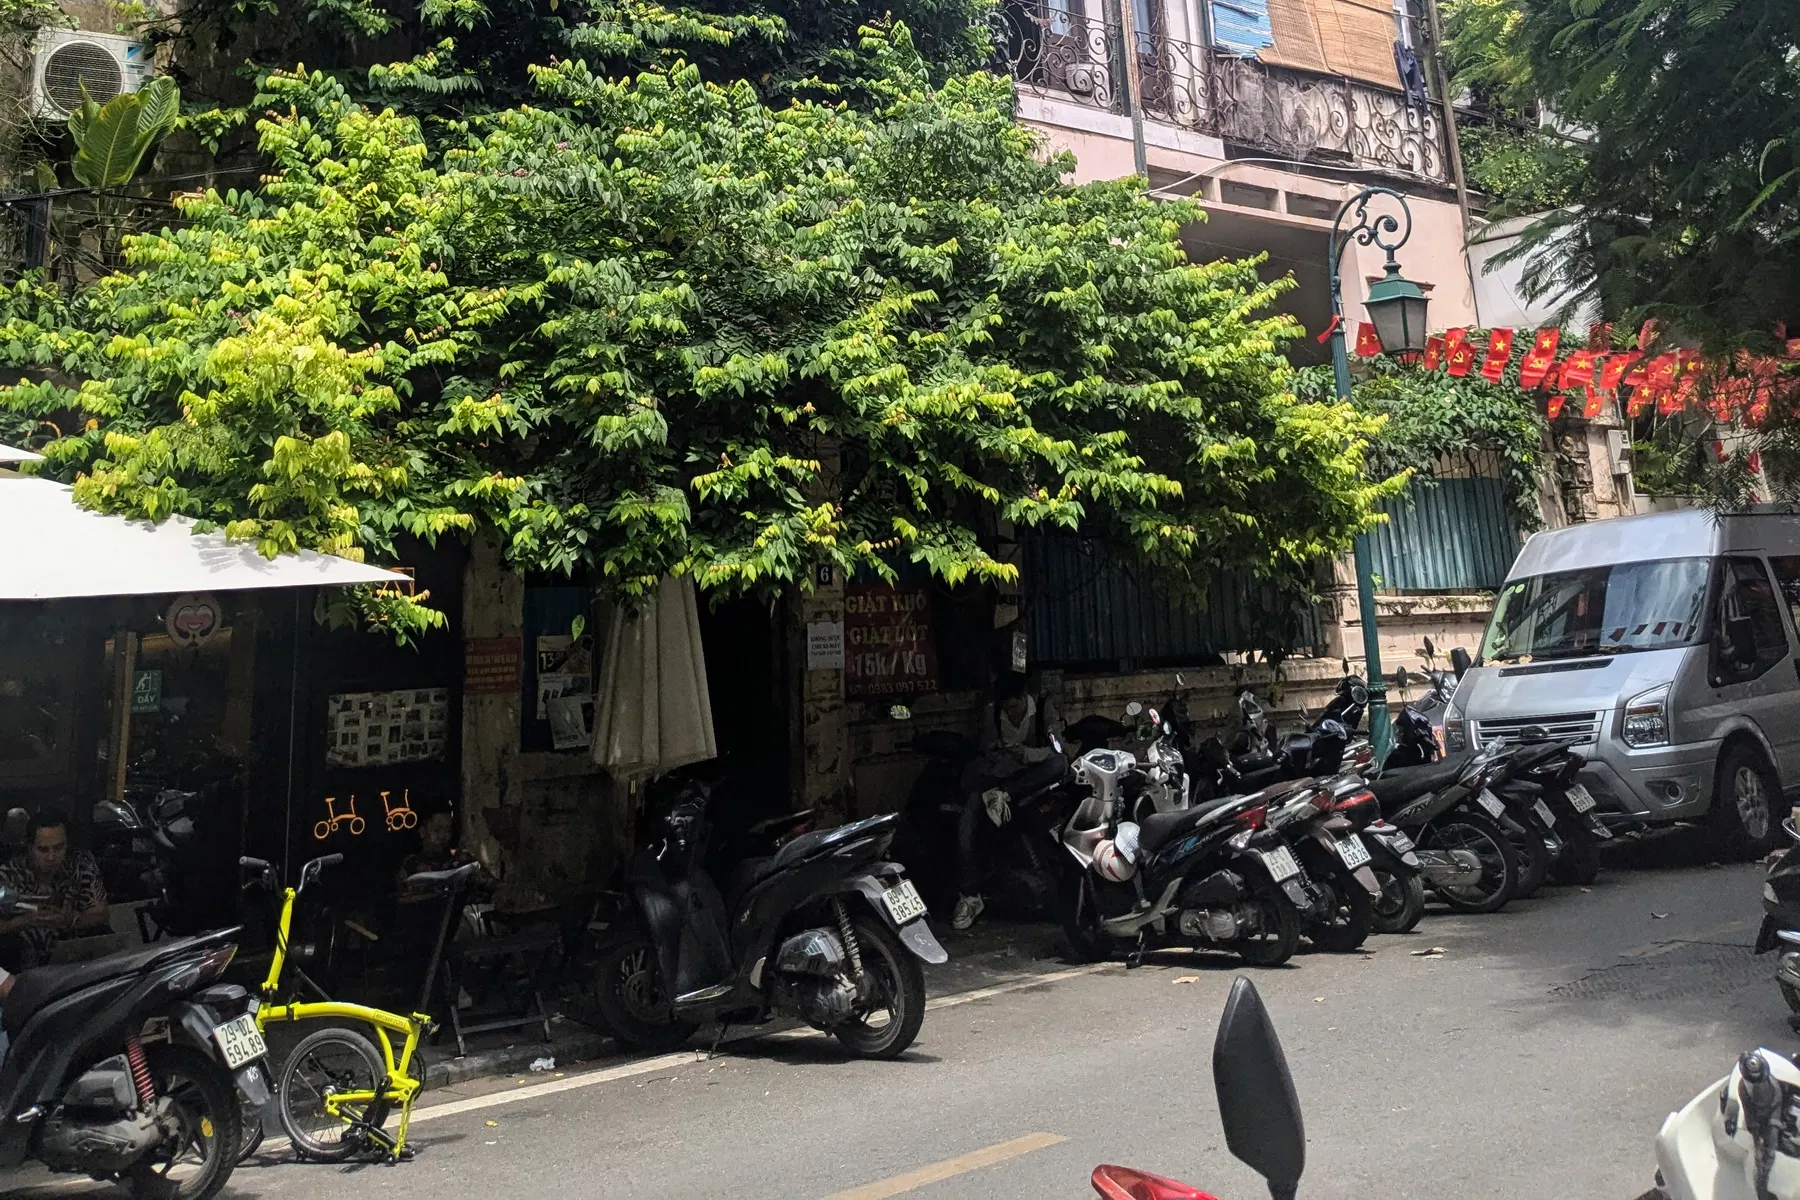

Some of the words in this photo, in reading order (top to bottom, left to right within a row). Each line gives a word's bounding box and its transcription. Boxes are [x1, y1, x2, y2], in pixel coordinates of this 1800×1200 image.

[820, 566, 829, 582] 6
[845, 588, 888, 617] GIẶT
[849, 622, 891, 648] GIẶT
[886, 884, 913, 905] 89-L1
[892, 896, 924, 921] 385.45
[221, 1017, 253, 1045] 29-D2
[226, 1034, 264, 1064] 594.89
